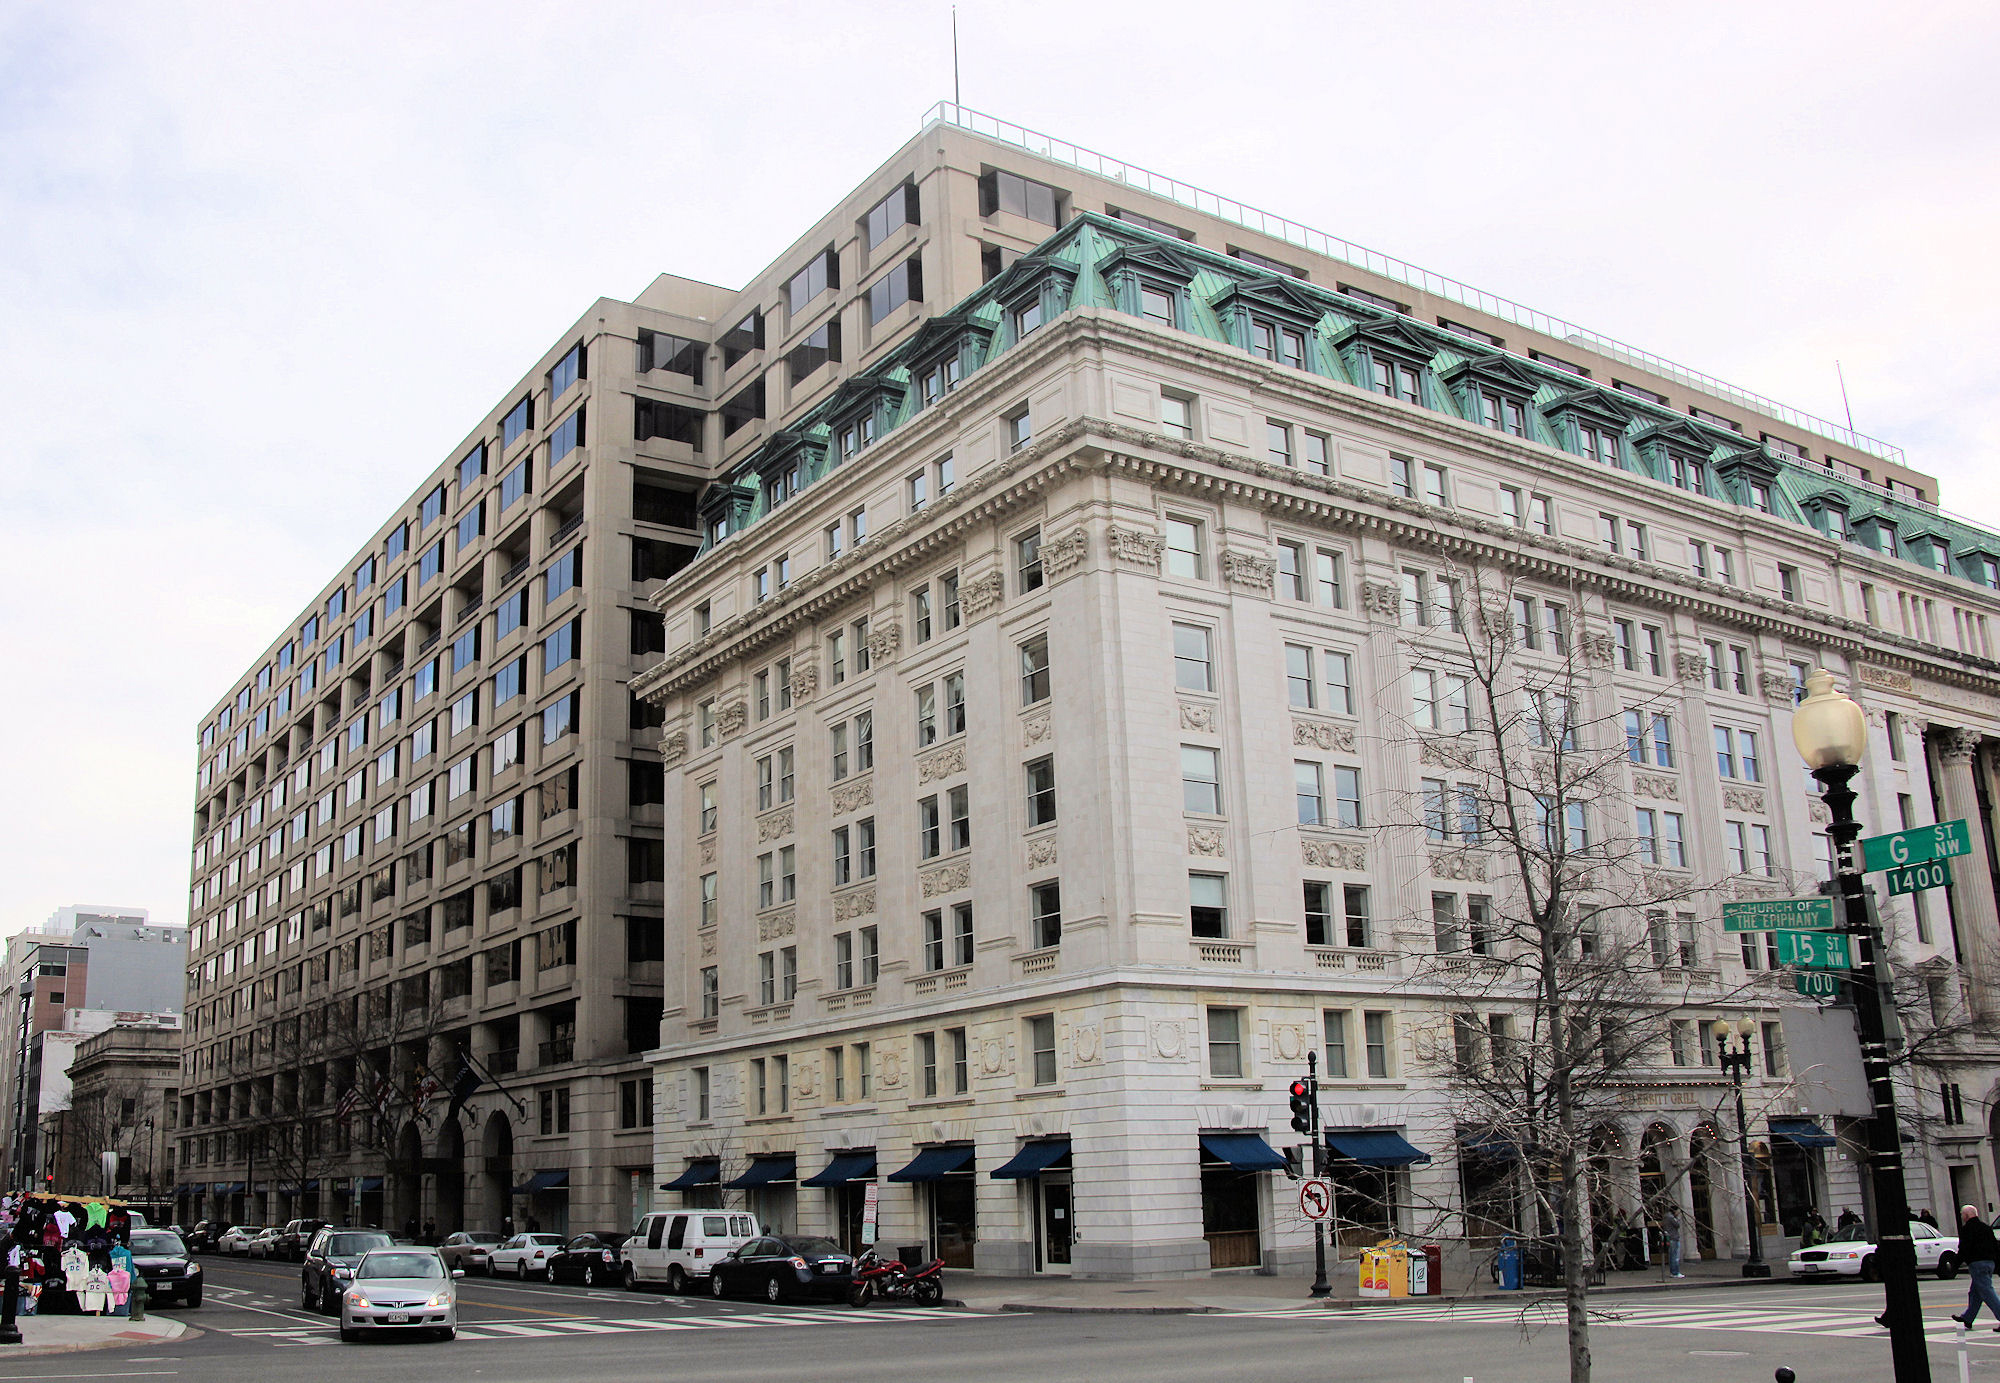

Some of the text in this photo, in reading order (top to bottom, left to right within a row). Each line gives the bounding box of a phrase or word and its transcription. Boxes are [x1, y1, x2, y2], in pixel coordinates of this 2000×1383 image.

[1889, 824, 1955, 863] G ST
[1935, 838, 1960, 858] NW
[1892, 864, 1945, 894] 1400
[1740, 901, 1814, 914] CHURCH OF
[1737, 911, 1819, 929] THE EPIPHANY
[1790, 933, 1840, 963] 15 ST
[1826, 950, 1843, 967] NW
[1803, 972, 1834, 994] 700
[1670, 1092, 1697, 1105] GRILL
